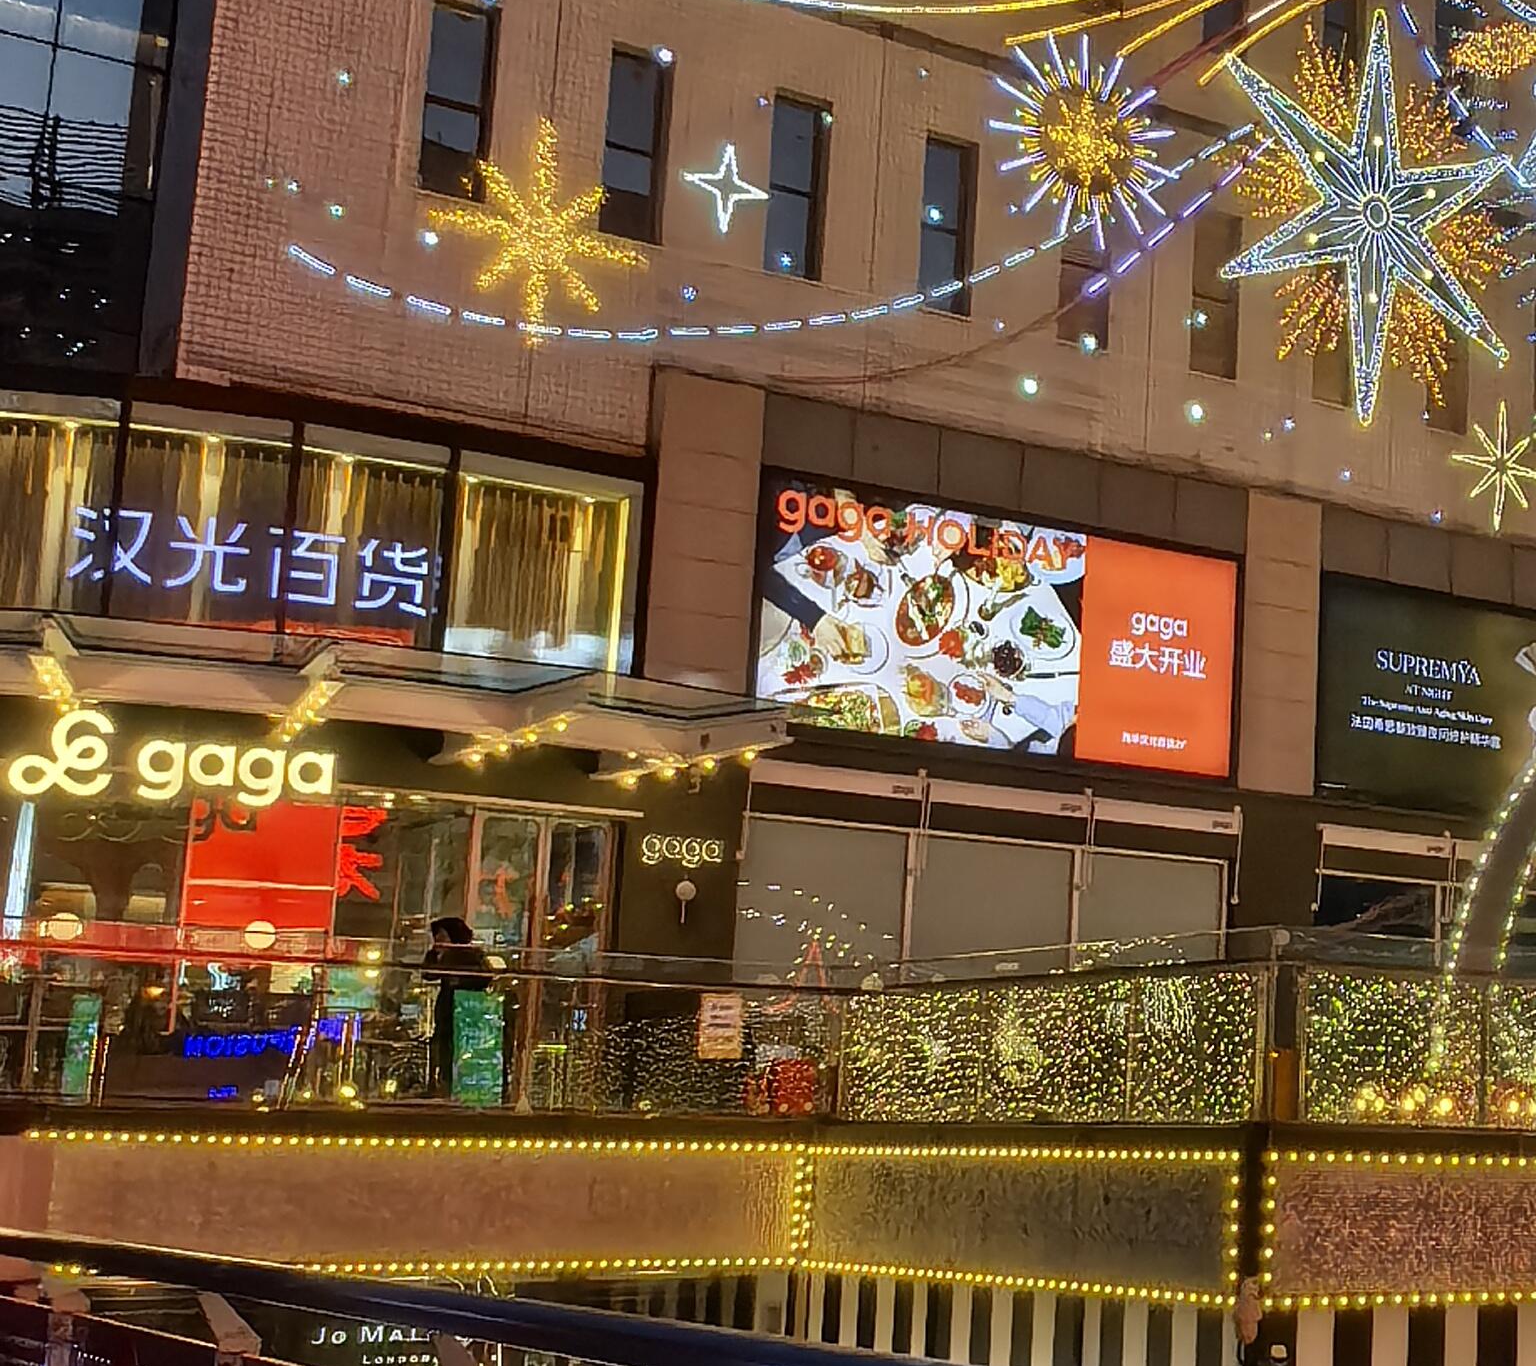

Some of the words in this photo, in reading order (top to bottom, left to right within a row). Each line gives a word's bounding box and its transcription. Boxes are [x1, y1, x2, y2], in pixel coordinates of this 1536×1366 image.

[775, 488, 893, 543] gaga
[904, 513, 1086, 571] HOLIDAY
[66, 506, 429, 617] 汉光百货
[1131, 612, 1188, 640] gaga
[1109, 639, 1206, 679] 盛大开业
[137, 739, 336, 806] gaga
[641, 833, 724, 868] gaga
[311, 1326, 347, 1345] Jo
